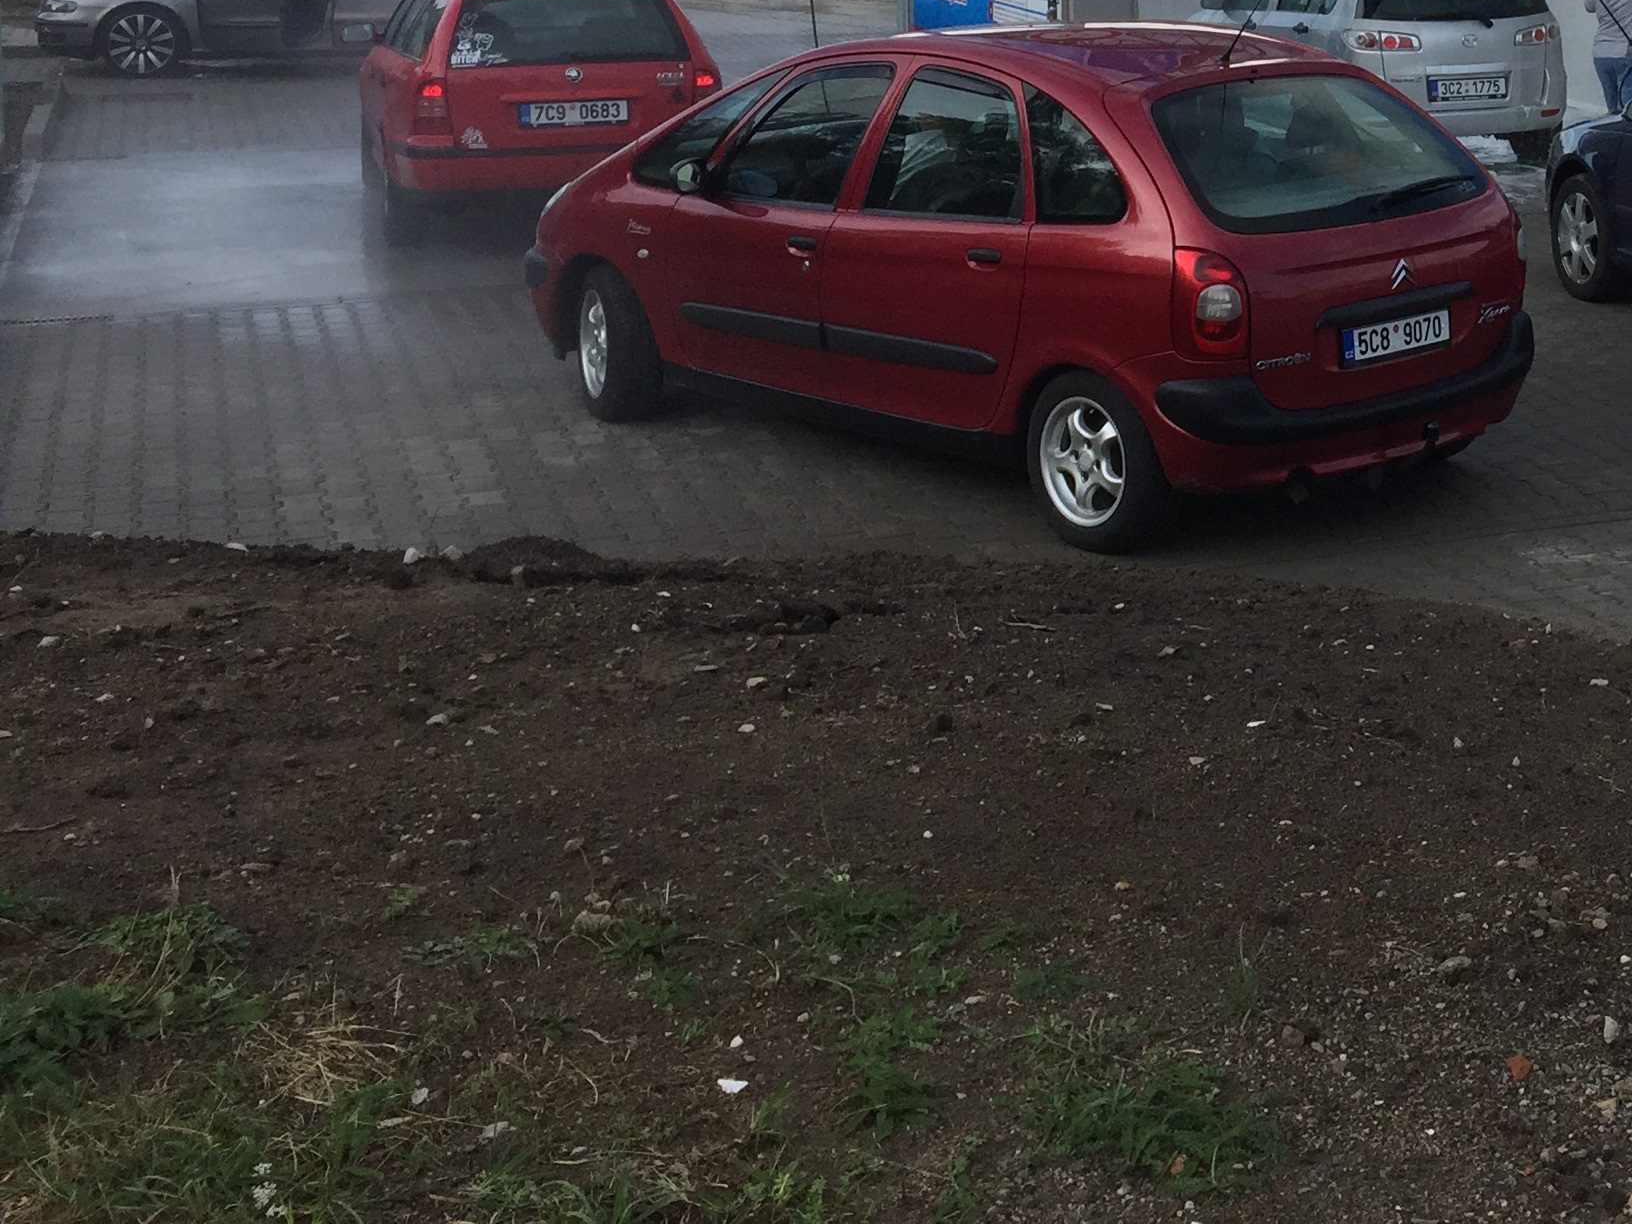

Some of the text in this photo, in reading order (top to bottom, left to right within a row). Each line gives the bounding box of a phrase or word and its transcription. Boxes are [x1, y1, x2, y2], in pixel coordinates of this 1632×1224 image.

[1440, 80, 1500, 95] 3C2 1775
[534, 102, 621, 122] 7C9 0683
[1357, 314, 1442, 356] 5C8 9070
